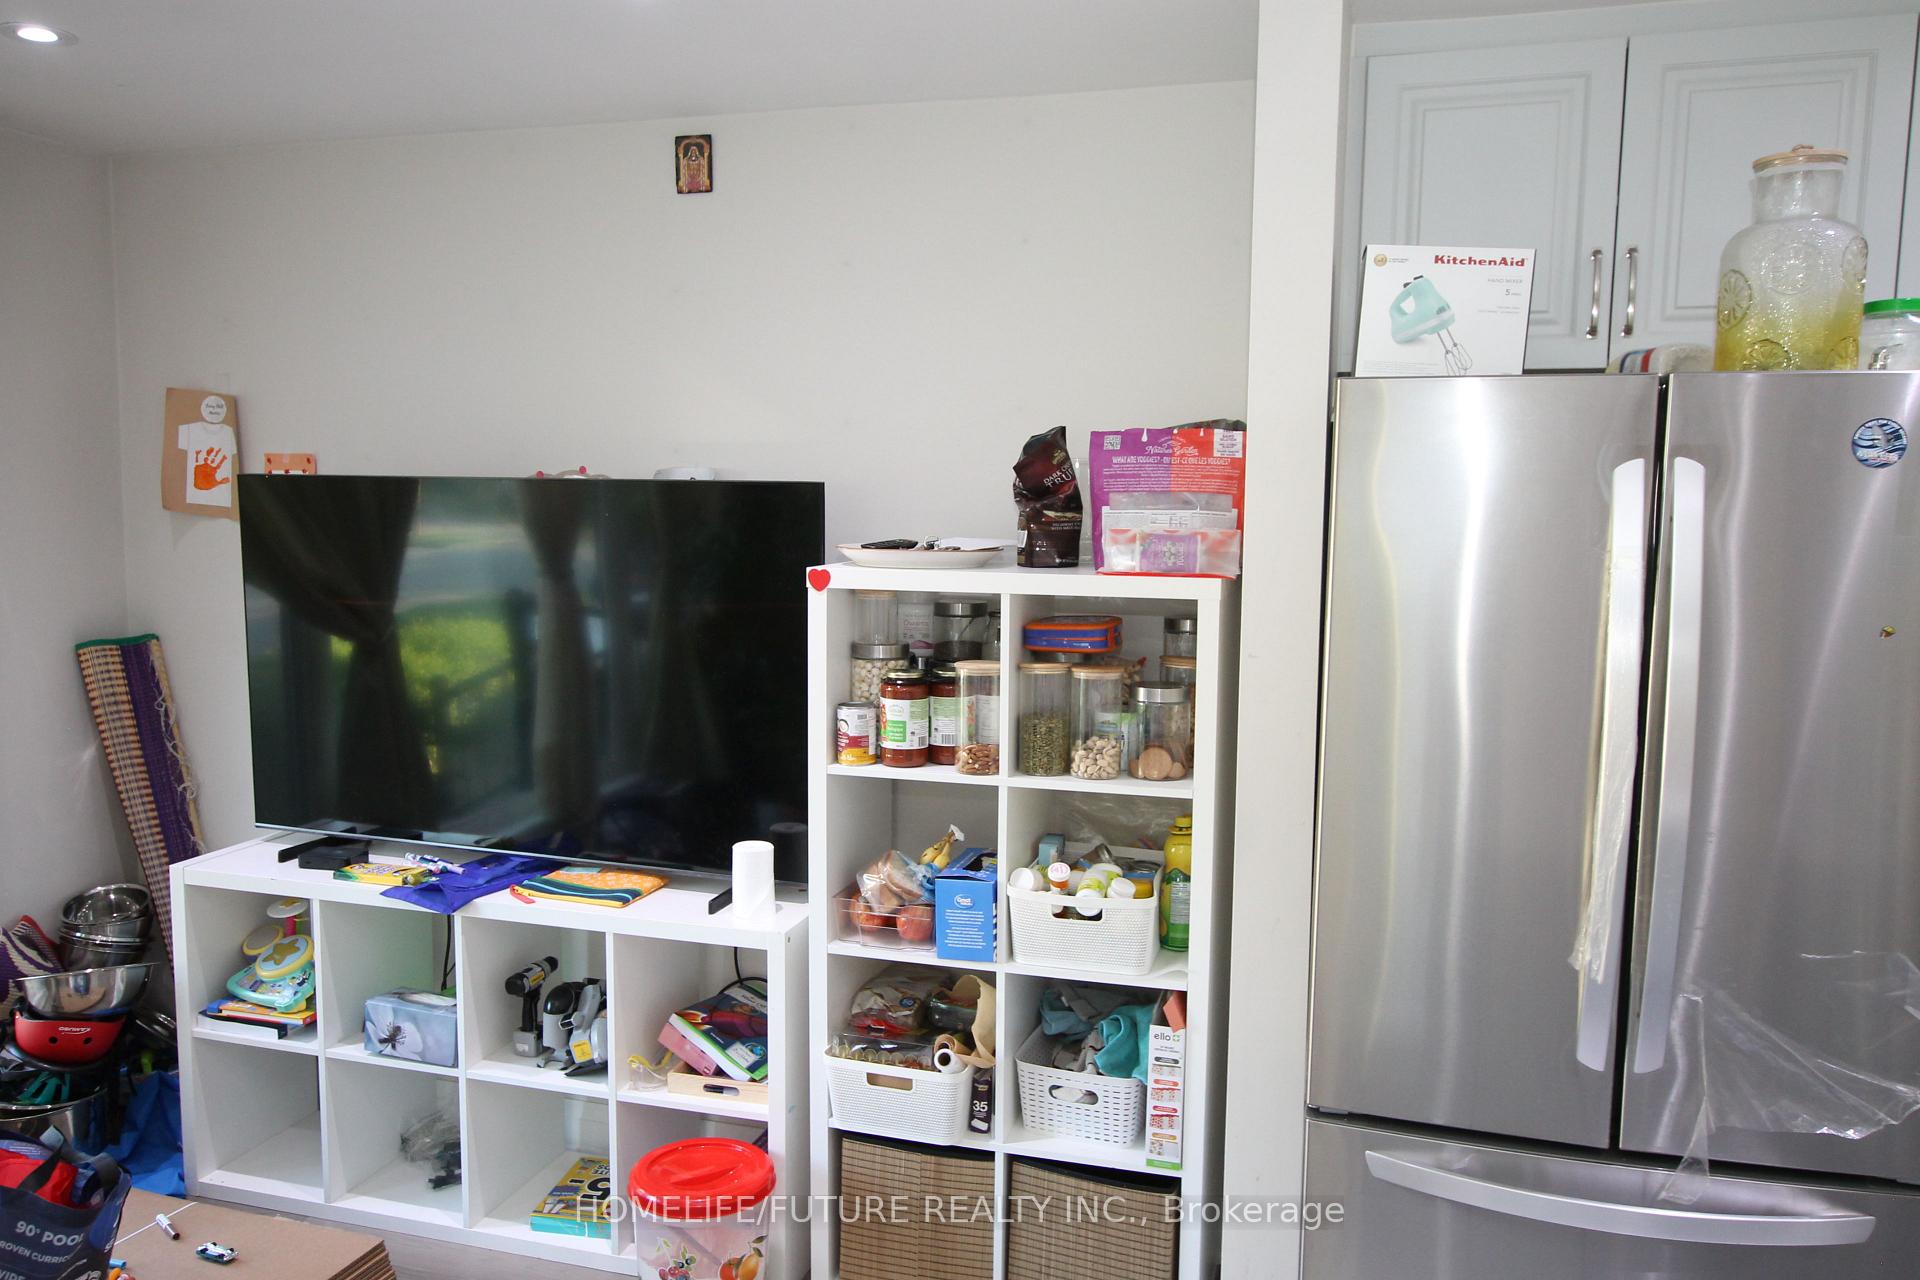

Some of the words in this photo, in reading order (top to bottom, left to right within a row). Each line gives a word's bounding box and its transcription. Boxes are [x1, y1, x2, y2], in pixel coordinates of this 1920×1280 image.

[1434, 255, 1525, 267] KitchenAid
[1154, 1033, 1171, 1041] ello
[973, 1100, 988, 1112] 35
